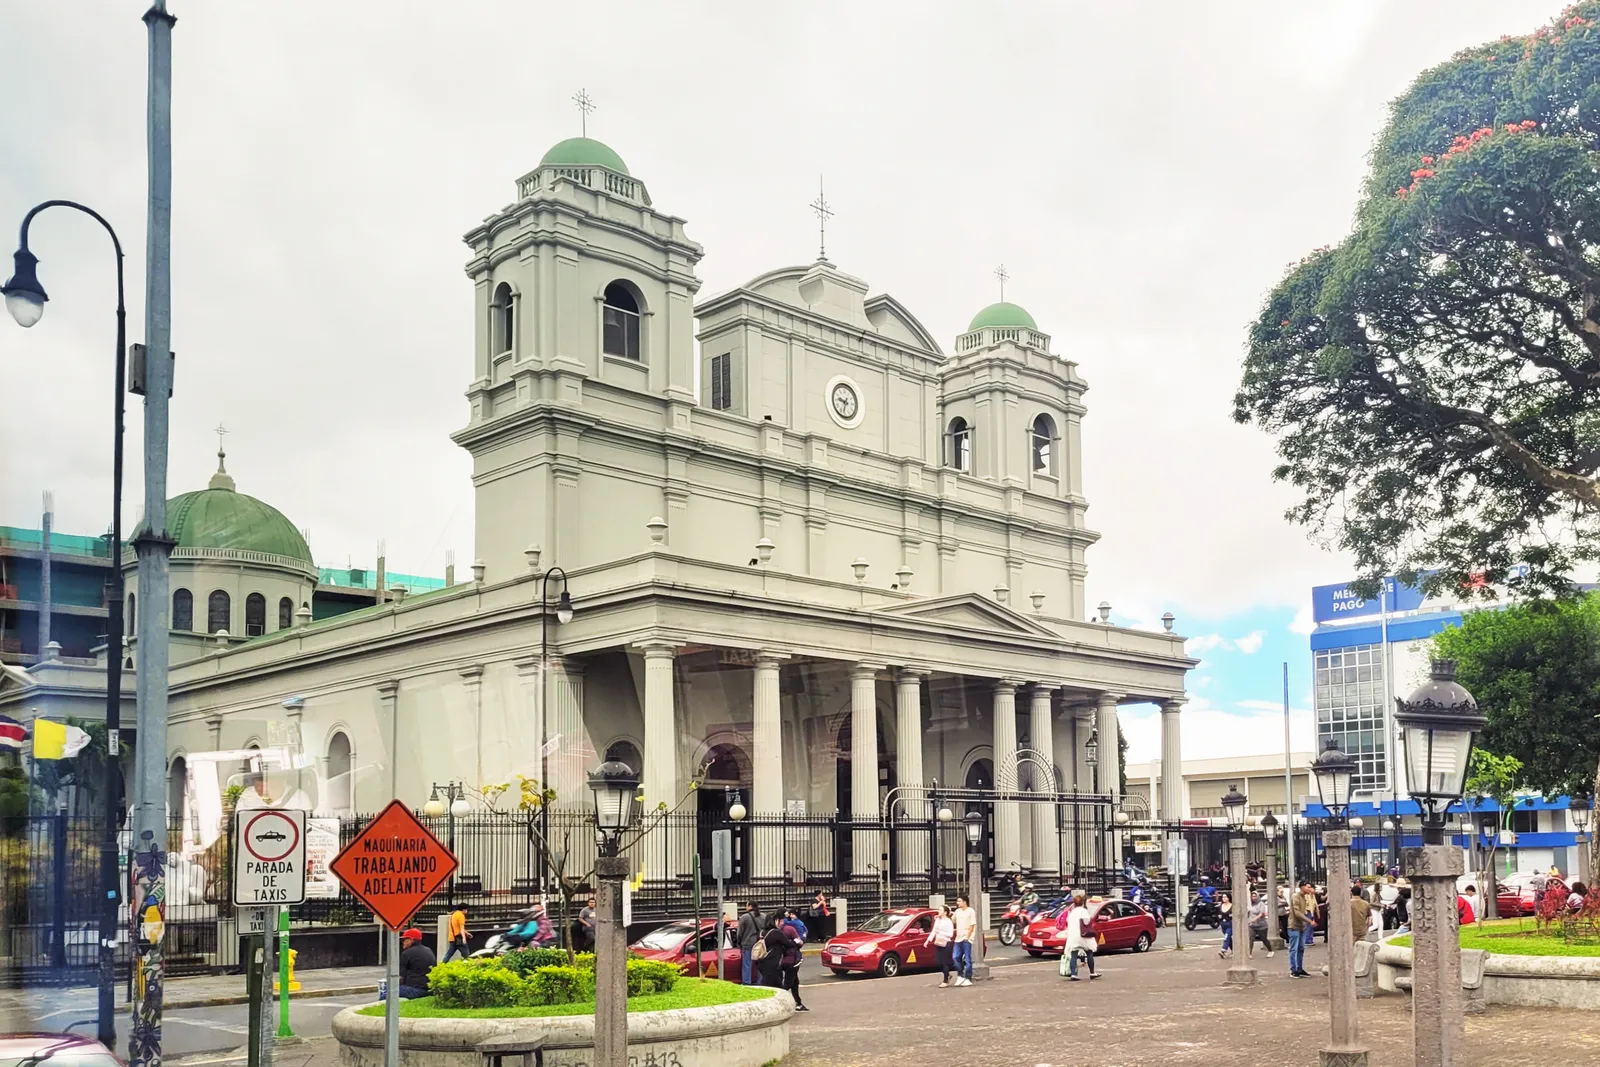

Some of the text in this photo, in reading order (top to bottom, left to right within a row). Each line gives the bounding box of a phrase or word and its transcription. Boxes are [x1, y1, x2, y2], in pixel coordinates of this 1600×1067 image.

[1333, 599, 1365, 612] PAGO
[364, 839, 427, 852] MAQUINARIA
[247, 861, 293, 874] PARADA
[354, 856, 437, 874] TRABAJANDO
[263, 875, 277, 887] DE
[364, 877, 427, 895] ADELANTE
[254, 888, 287, 901] TAXIS
[250, 922, 265, 931] TAXI
